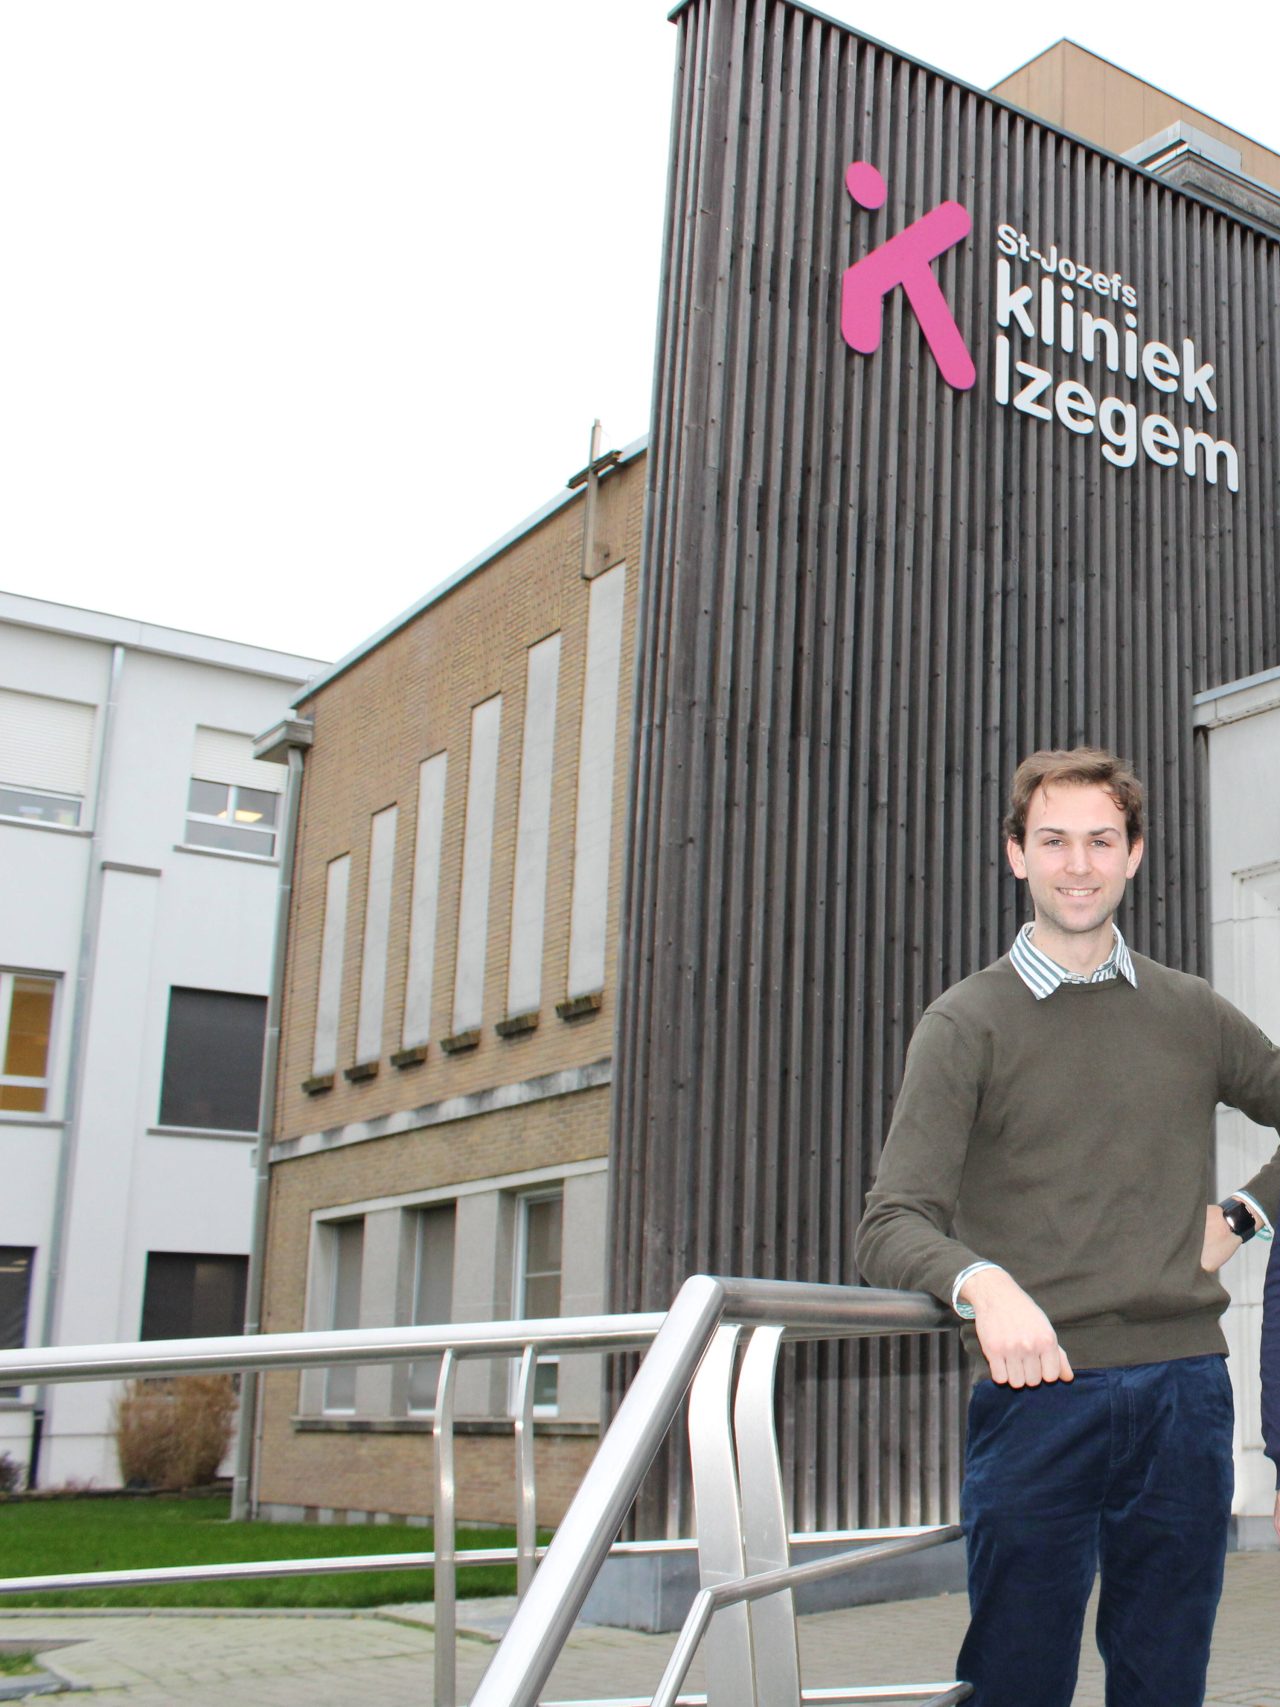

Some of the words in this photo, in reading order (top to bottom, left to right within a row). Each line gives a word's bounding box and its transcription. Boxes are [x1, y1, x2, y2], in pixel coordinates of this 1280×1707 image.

[996, 258, 1217, 412] kliniek
[997, 224, 1137, 307] St-Jozefs
[995, 335, 1239, 492] Izegem
